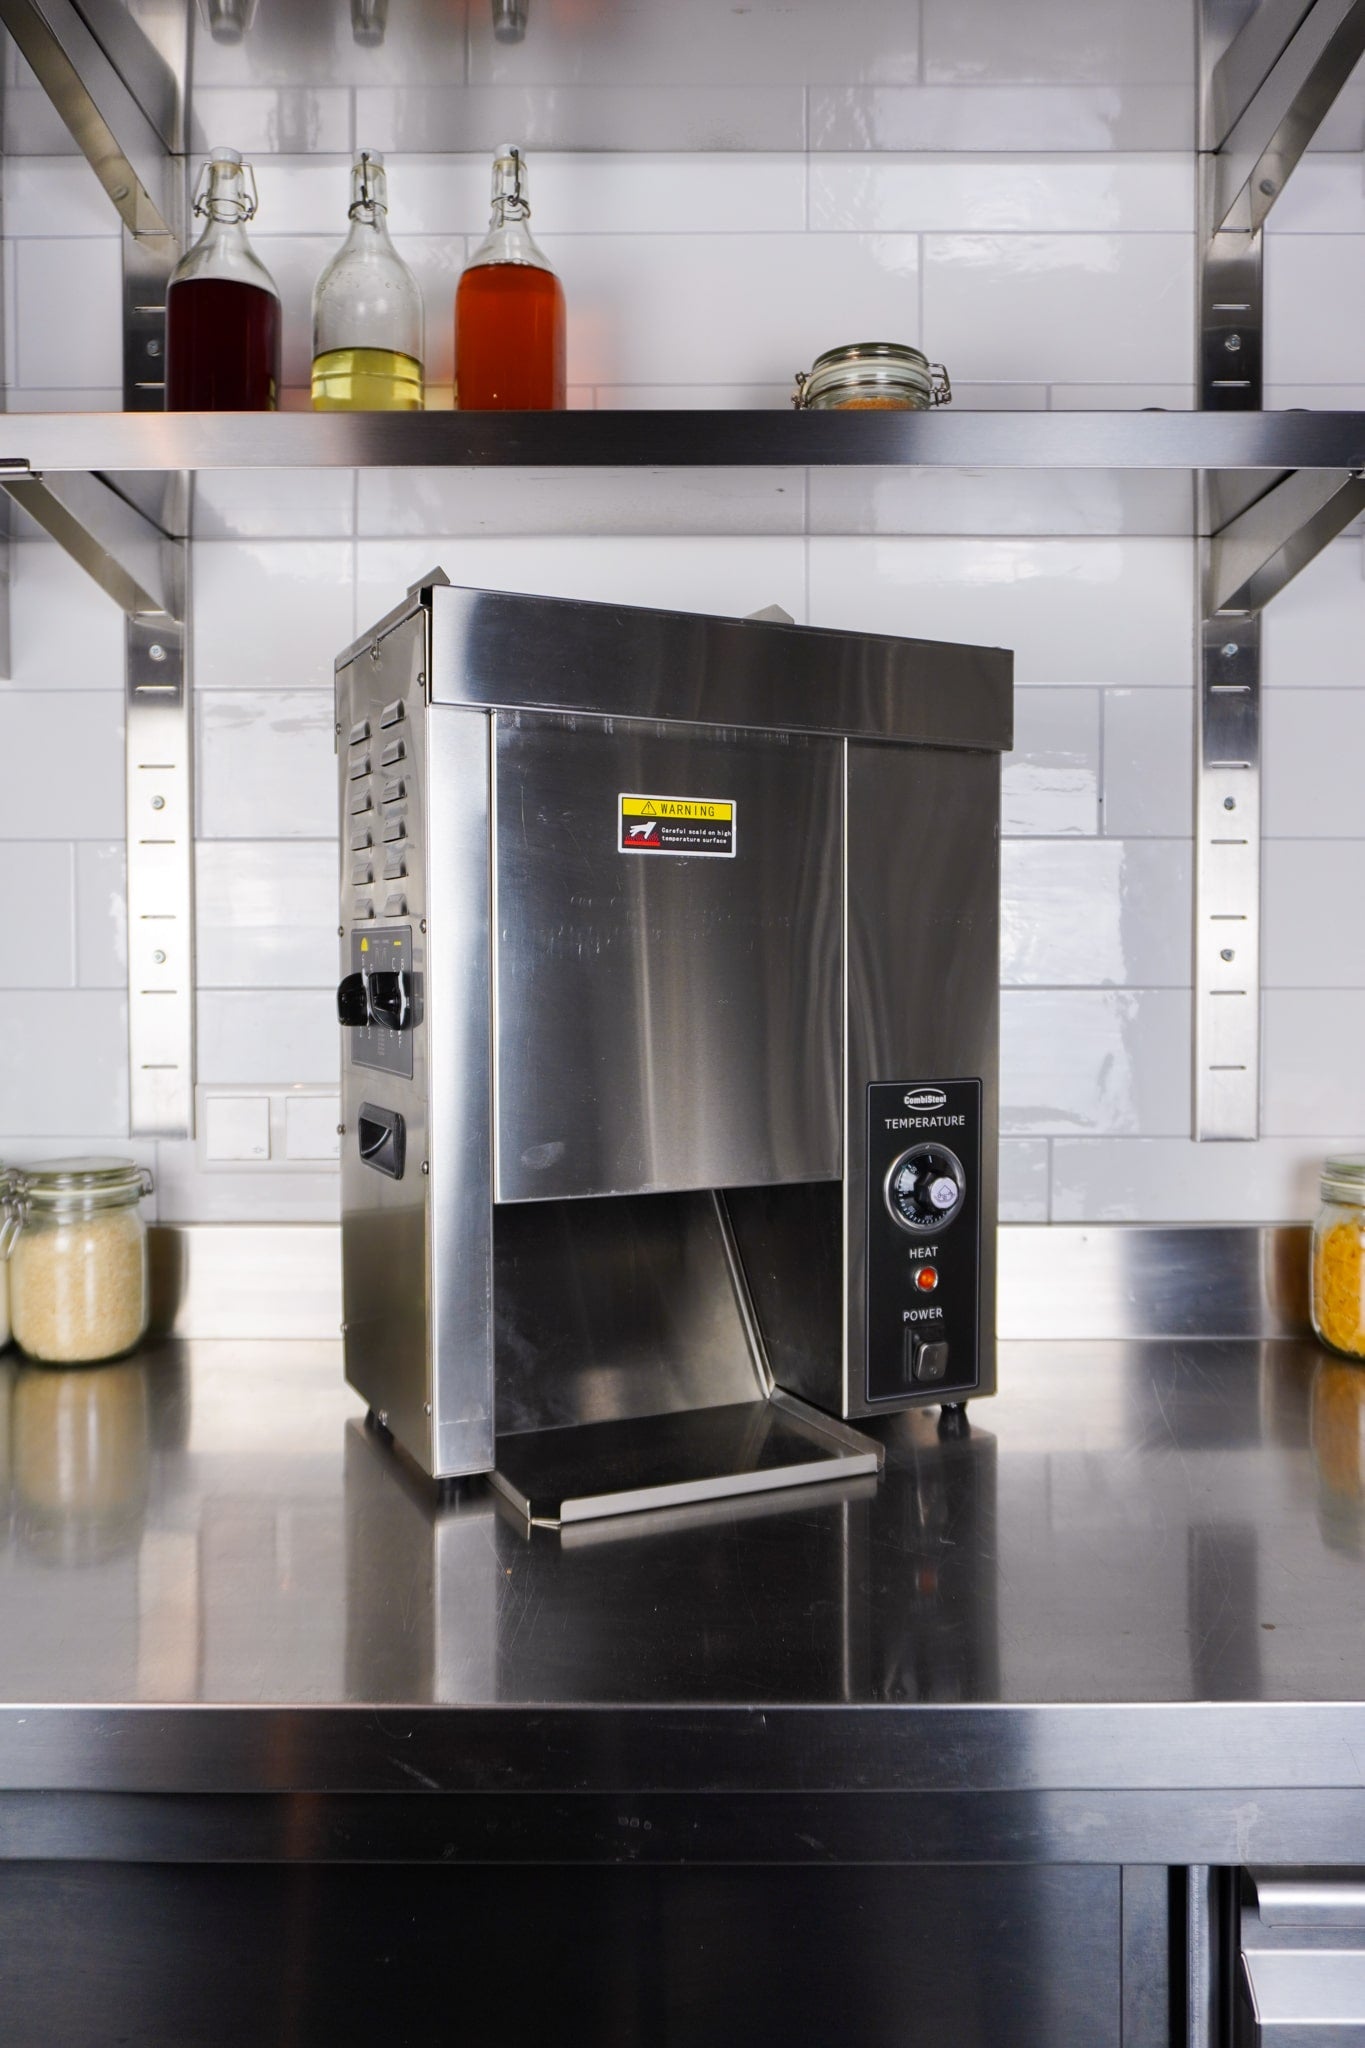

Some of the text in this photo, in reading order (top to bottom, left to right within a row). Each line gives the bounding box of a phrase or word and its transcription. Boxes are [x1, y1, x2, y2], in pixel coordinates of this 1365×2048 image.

[660, 803, 715, 817] WARNING
[661, 835, 701, 843] temperature
[717, 829, 732, 837] high
[903, 1094, 947, 1105] CombiSteel
[884, 1115, 966, 1130] TEMPERATURE
[909, 1246, 939, 1260] HEAT
[903, 1307, 944, 1322] POWER
